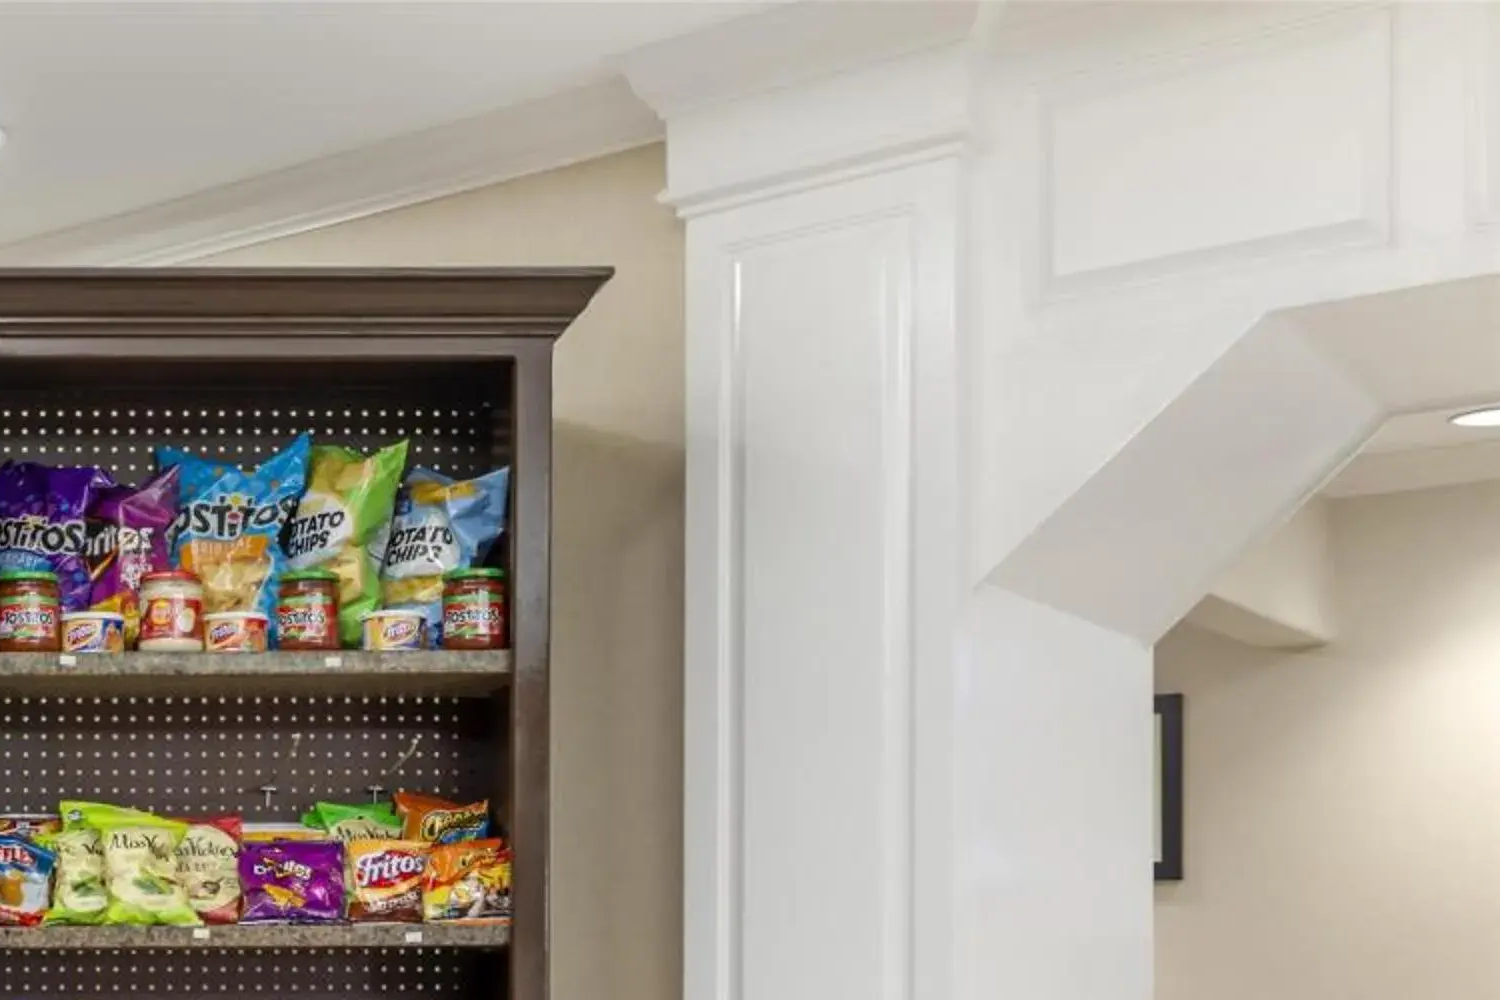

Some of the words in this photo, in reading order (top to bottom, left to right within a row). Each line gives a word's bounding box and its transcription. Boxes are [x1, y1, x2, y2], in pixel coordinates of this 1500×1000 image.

[290, 511, 345, 537] OTATO
[111, 832, 146, 851] Miss
[356, 853, 424, 887] Fritos
